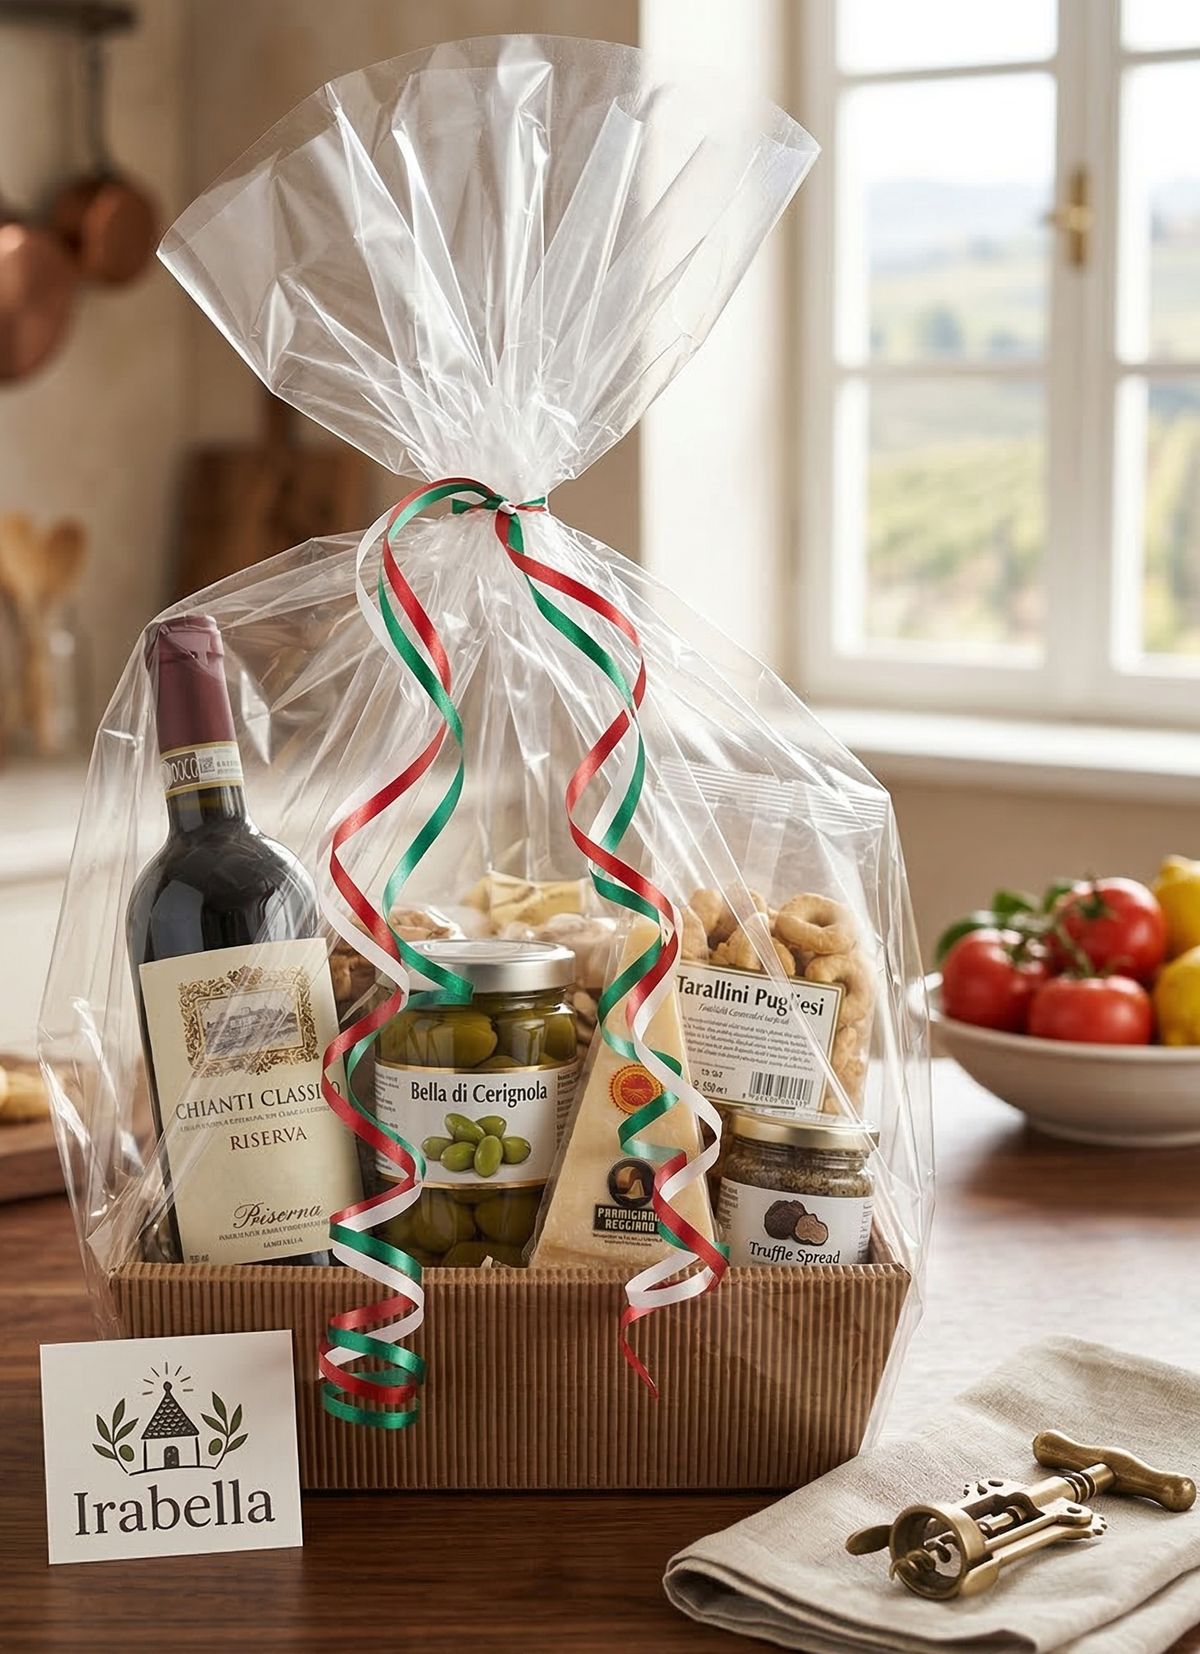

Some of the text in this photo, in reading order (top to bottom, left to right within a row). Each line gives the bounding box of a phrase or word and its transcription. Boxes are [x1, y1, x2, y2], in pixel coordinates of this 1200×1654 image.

[676, 975, 750, 1004] Tarallini
[176, 1093, 254, 1120] CHIANTI
[260, 1081, 341, 1107] CLASSIO
[411, 1081, 447, 1102] Bella
[452, 1083, 468, 1103] di
[472, 1080, 548, 1108] Cerignola
[230, 1126, 308, 1151] RISERVA
[605, 1219, 655, 1233] REGGIANO
[749, 1241, 841, 1266] Truffle Spread
[73, 1479, 276, 1536] Irabella
